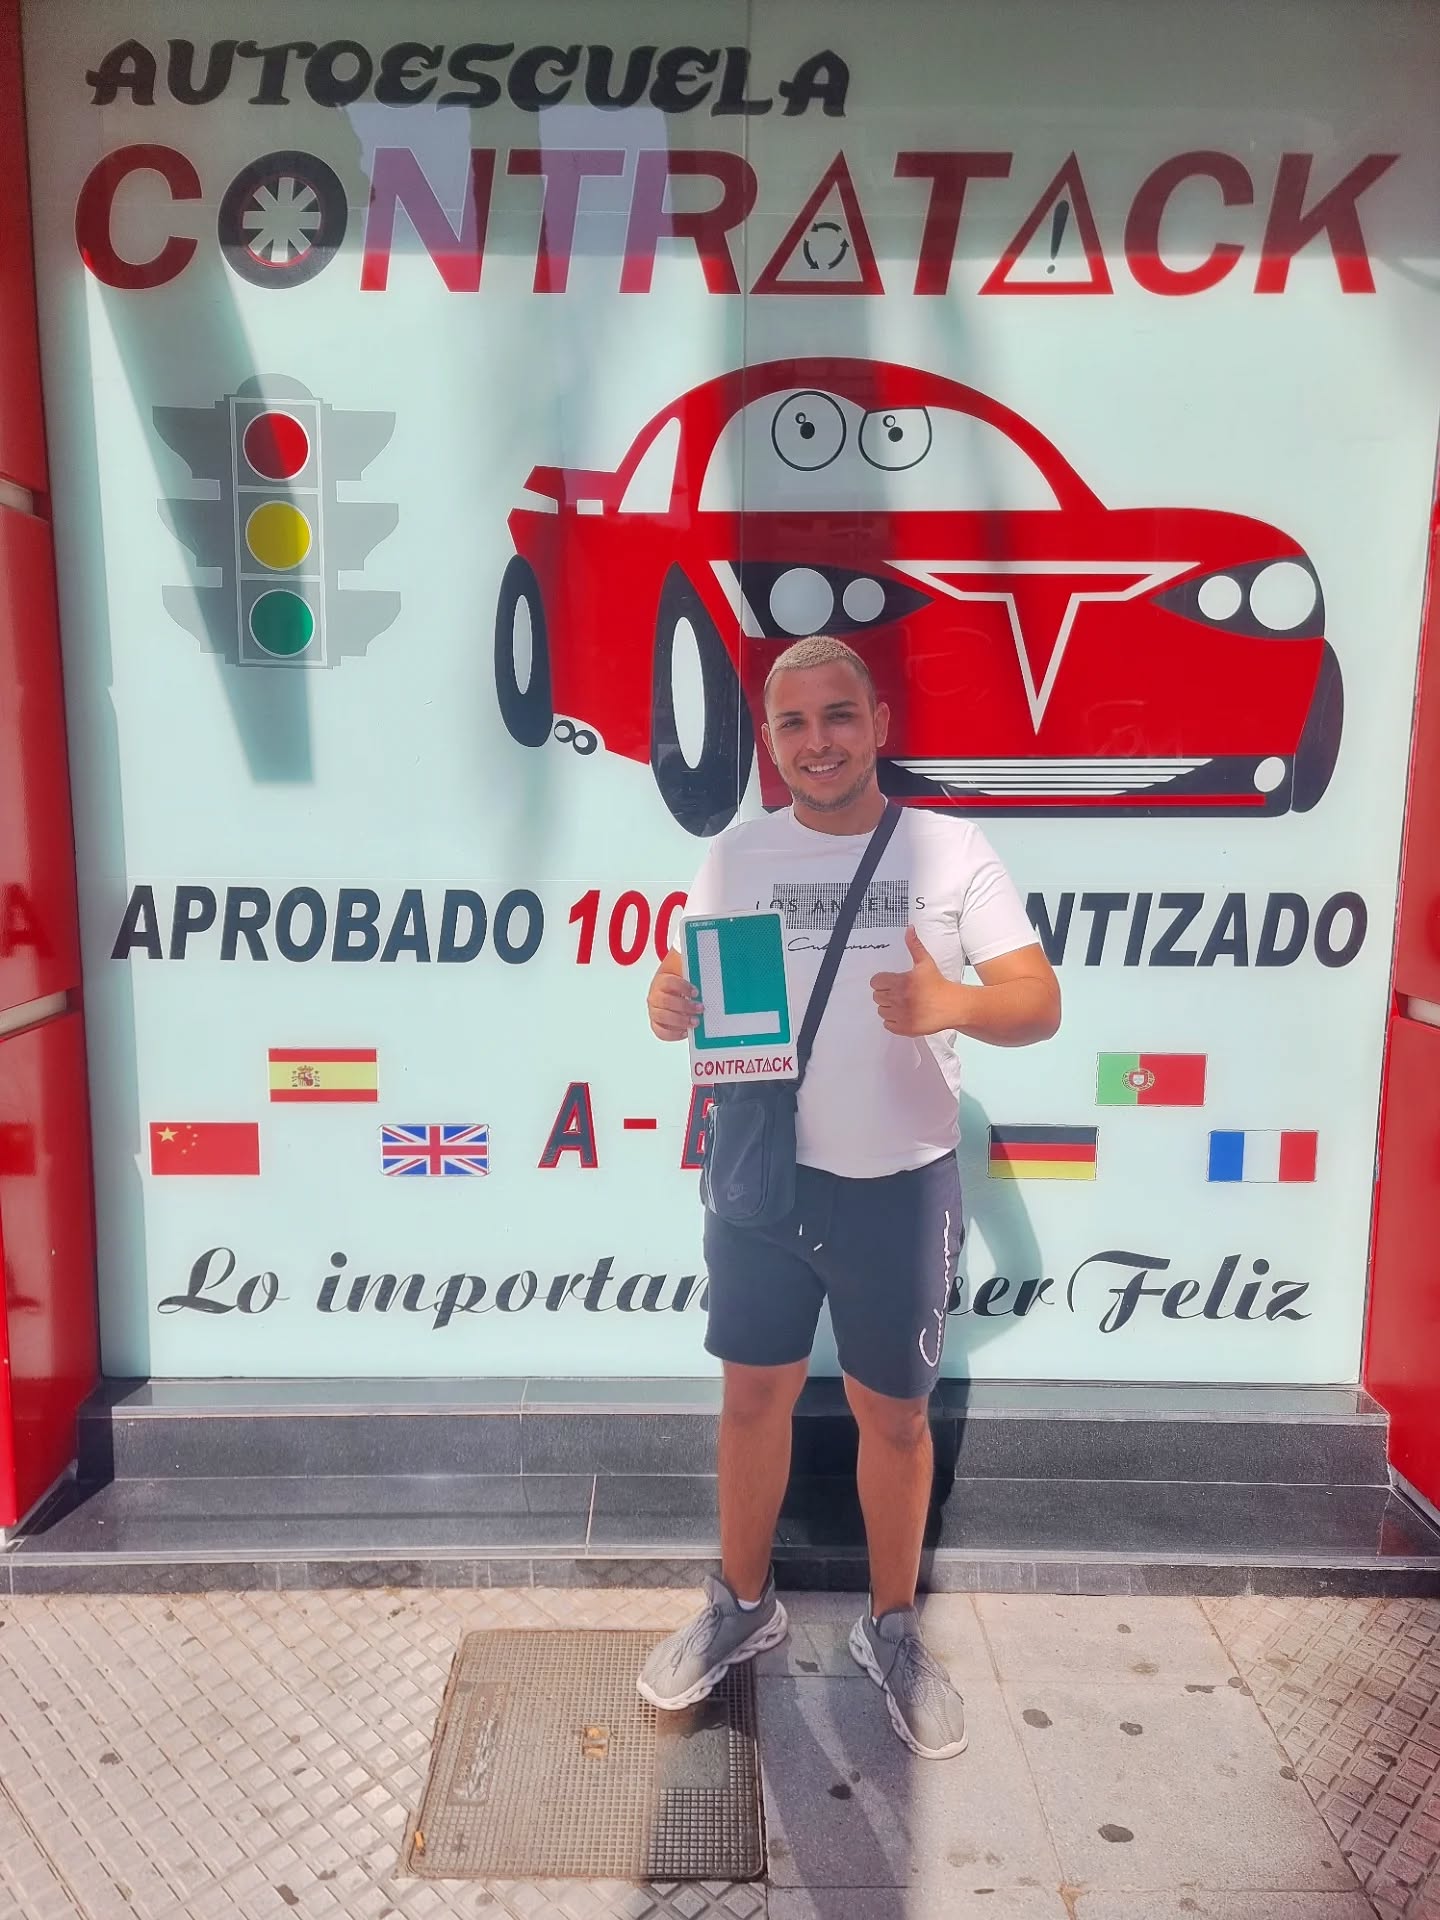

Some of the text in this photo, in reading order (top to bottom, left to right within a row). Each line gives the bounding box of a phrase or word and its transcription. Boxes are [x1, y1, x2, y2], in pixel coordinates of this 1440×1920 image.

[86, 39, 850, 117] AUTOESCUELA
[75, 143, 1400, 295] CONTRATACK
[111, 885, 545, 965] APROBADO
[1025, 892, 1368, 968] NTIZADO
[812, 897, 926, 913] ANELES
[696, 929, 782, 1039] L
[694, 1056, 794, 1077] CONTRATACK
[537, 1082, 599, 1169] A
[157, 1247, 290, 1315] Lo
[316, 1252, 709, 1330] importan
[1066, 1250, 1313, 1334] Feliz
